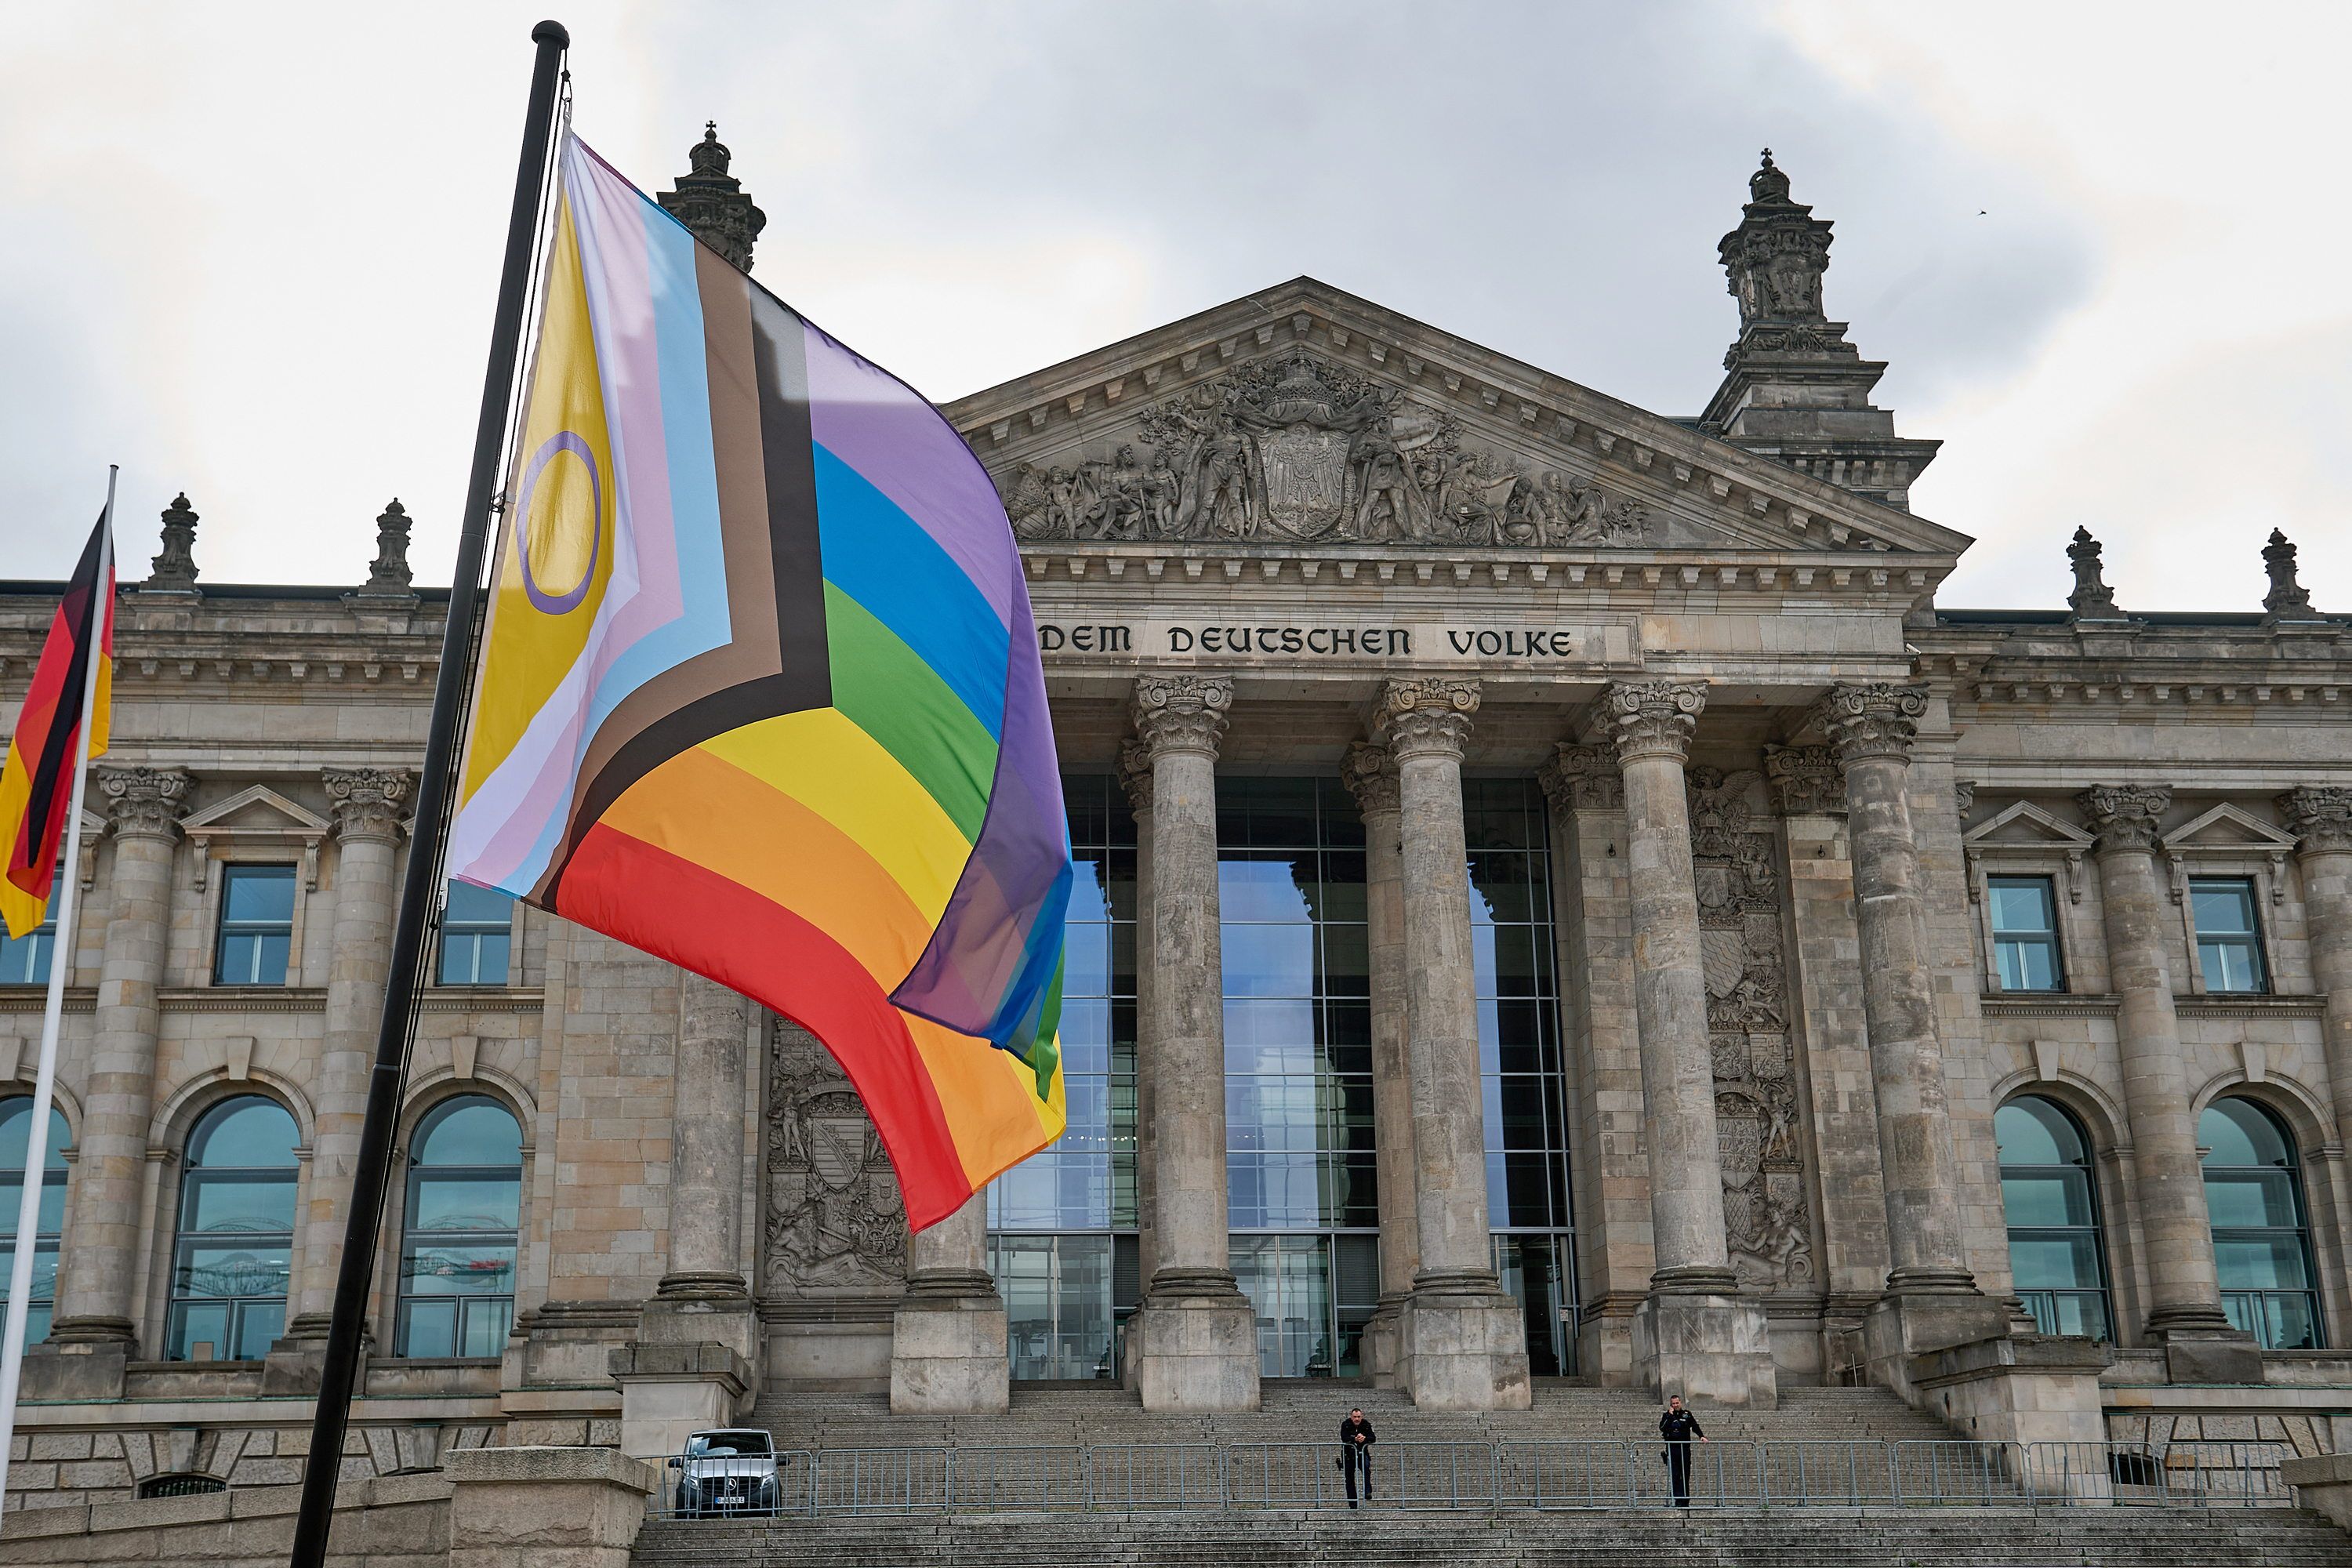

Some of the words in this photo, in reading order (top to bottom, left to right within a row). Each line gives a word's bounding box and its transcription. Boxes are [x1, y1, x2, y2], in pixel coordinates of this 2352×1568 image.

[1037, 625, 1131, 652] DEM
[1167, 626, 1411, 655] DEUTSCHEN
[1447, 630, 1572, 657] VOLKE
